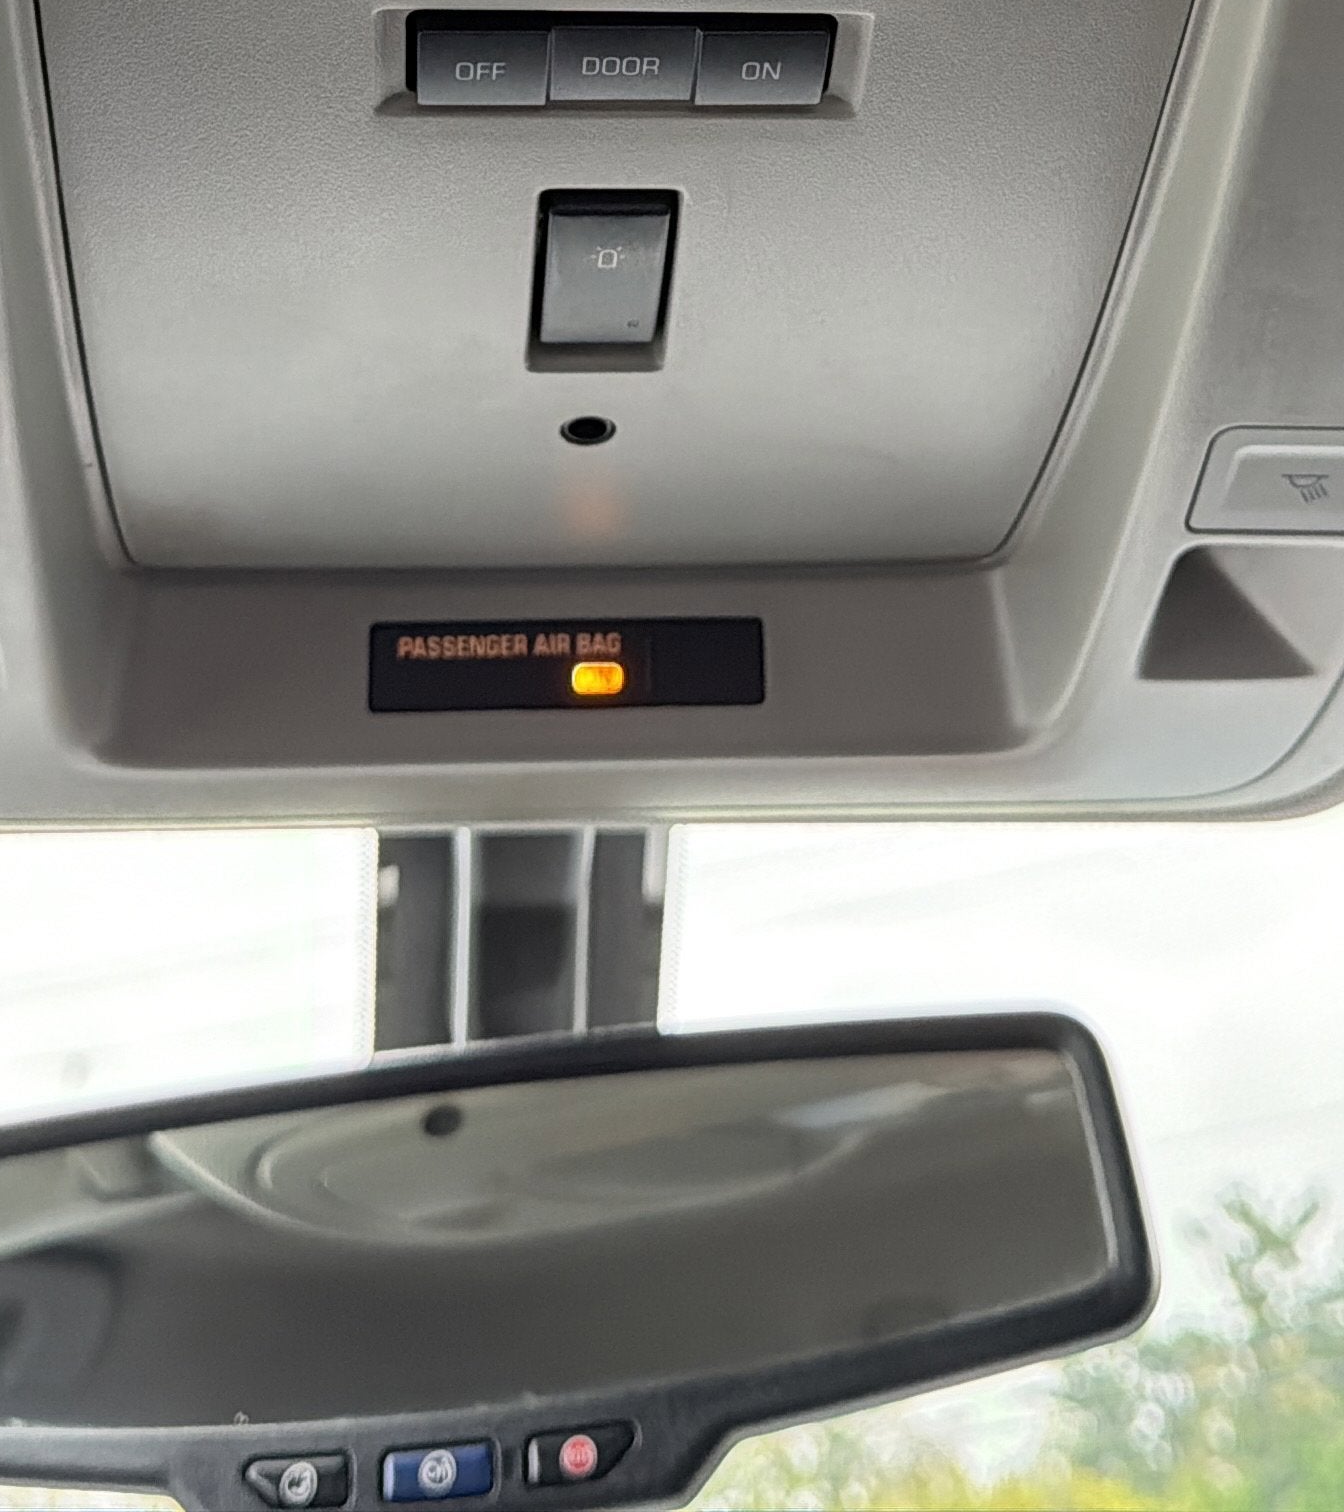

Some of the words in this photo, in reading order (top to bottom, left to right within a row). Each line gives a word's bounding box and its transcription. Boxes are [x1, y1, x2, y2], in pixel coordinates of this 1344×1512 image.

[456, 62, 506, 81] OFF
[582, 57, 660, 77] DOOR
[741, 61, 781, 81] ON
[396, 634, 528, 658] PASSENGER
[532, 633, 571, 656] AIR
[576, 632, 622, 656] BAG
